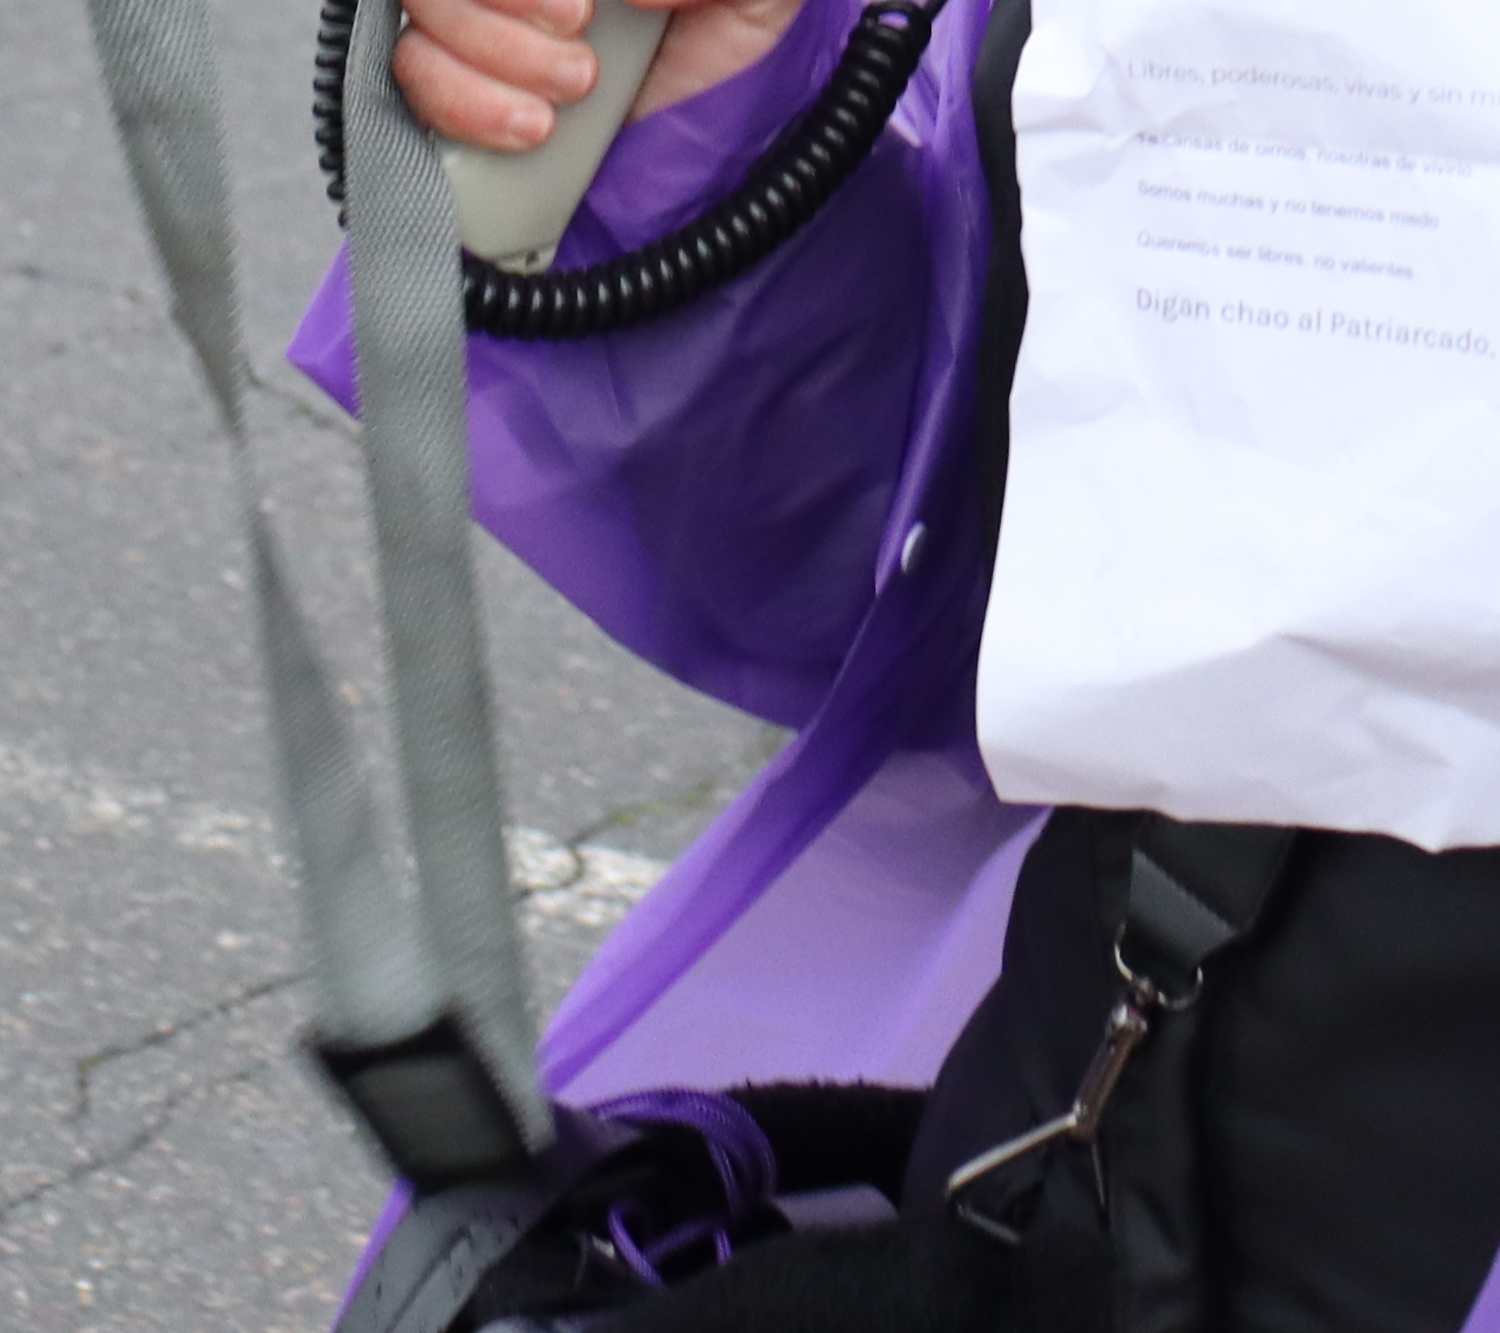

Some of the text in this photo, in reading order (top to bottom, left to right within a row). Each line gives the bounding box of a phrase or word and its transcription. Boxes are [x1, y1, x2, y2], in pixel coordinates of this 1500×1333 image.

[1127, 60, 1205, 85] Libres,
[1211, 63, 1338, 96] poderosas,
[1344, 77, 1402, 102] vivas
[1408, 85, 1422, 105] y
[1428, 83, 1463, 107] sin
[1228, 138, 1250, 155] de
[1317, 148, 1391, 170] nosotras
[1396, 155, 1416, 173] de
[1137, 179, 1440, 230] Somos muchas y no tenemos miedo
[1137, 230, 1220, 257] Queremos
[1226, 244, 1252, 261] ser
[1314, 254, 1335, 271] no
[1135, 287, 1211, 324] Digan
[1220, 299, 1290, 330] chao
[1297, 308, 1322, 333] al
[1329, 310, 1496, 361] Patriarcado,
